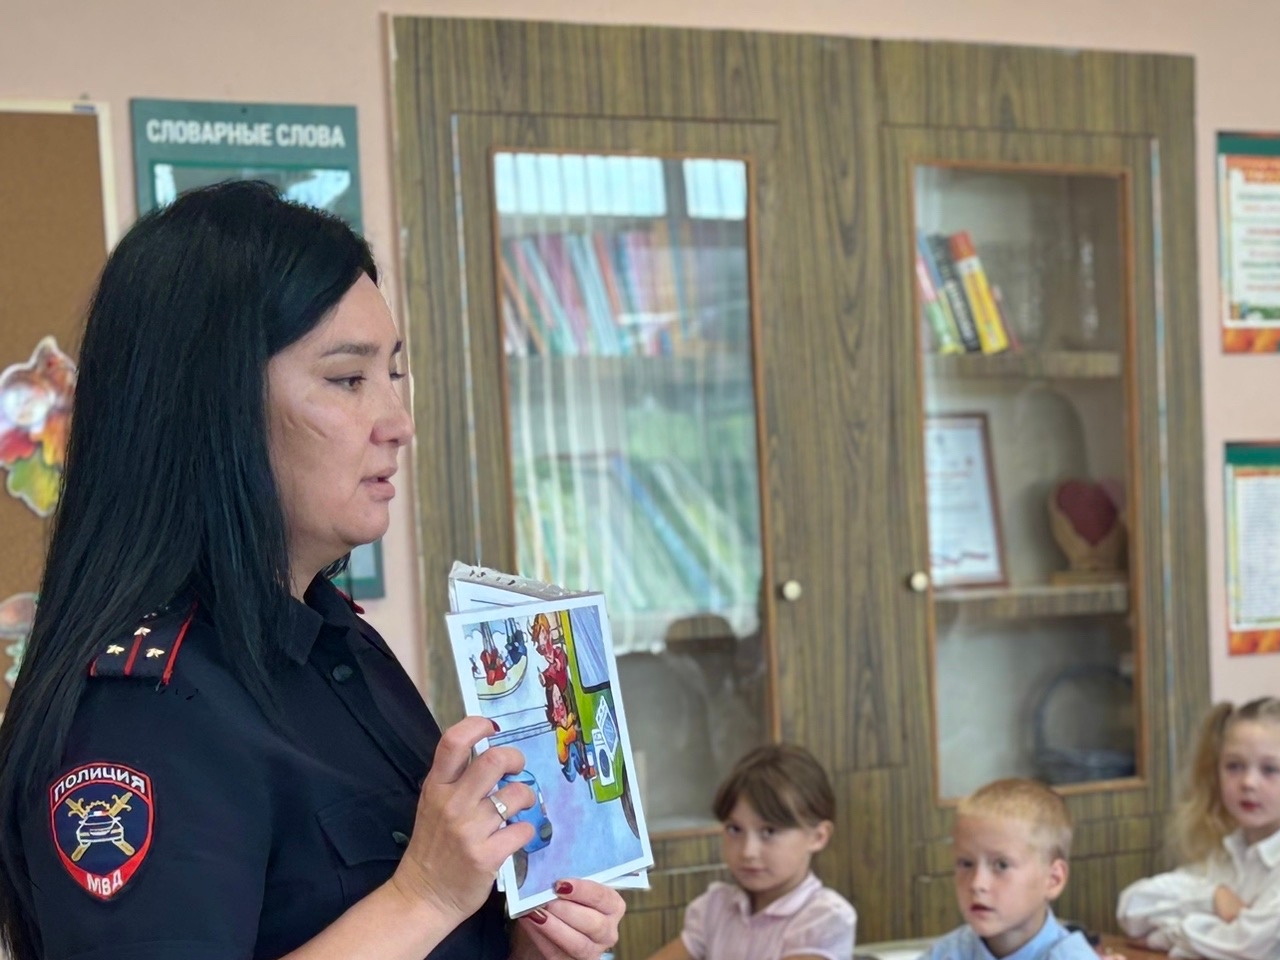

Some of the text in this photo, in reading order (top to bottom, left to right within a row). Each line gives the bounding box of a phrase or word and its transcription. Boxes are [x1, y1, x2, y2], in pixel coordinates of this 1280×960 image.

[146, 119, 346, 148] СЛОВАРНЫЕ СЛОВА
[54, 767, 146, 802] ПОЛИЦИЯ
[87, 869, 123, 896] МВД
